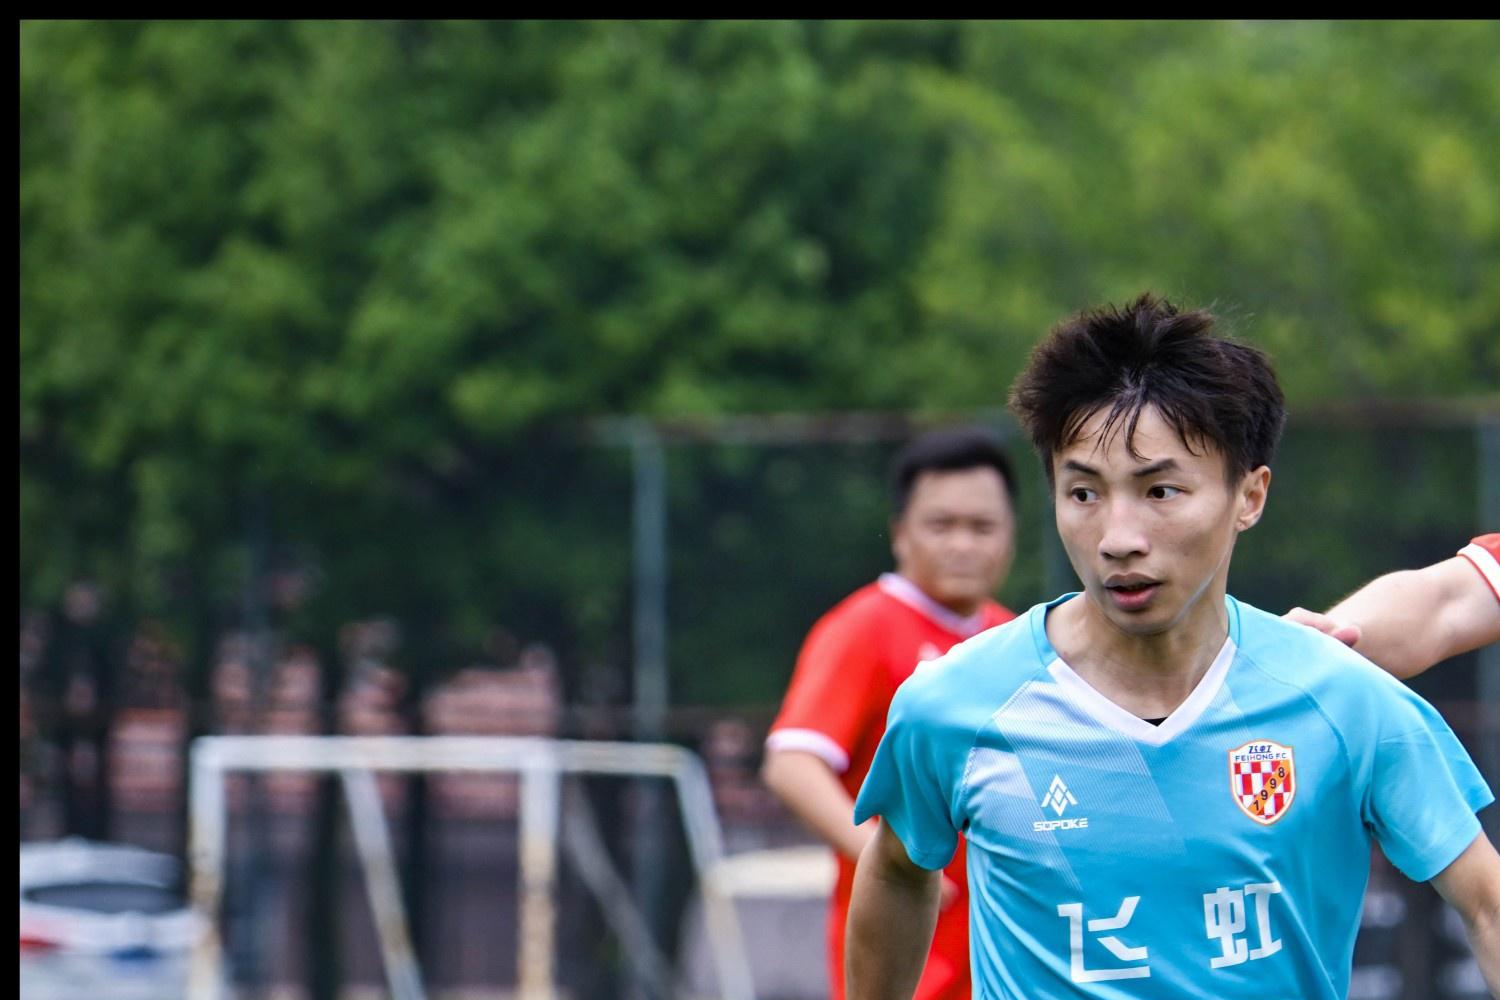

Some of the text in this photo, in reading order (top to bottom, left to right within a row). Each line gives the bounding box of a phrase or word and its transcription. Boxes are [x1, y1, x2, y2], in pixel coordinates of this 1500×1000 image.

[1254, 767, 1285, 810] 1998
[1033, 817, 1089, 831] SOPOKE
[1057, 881, 1282, 984] 飞虹
